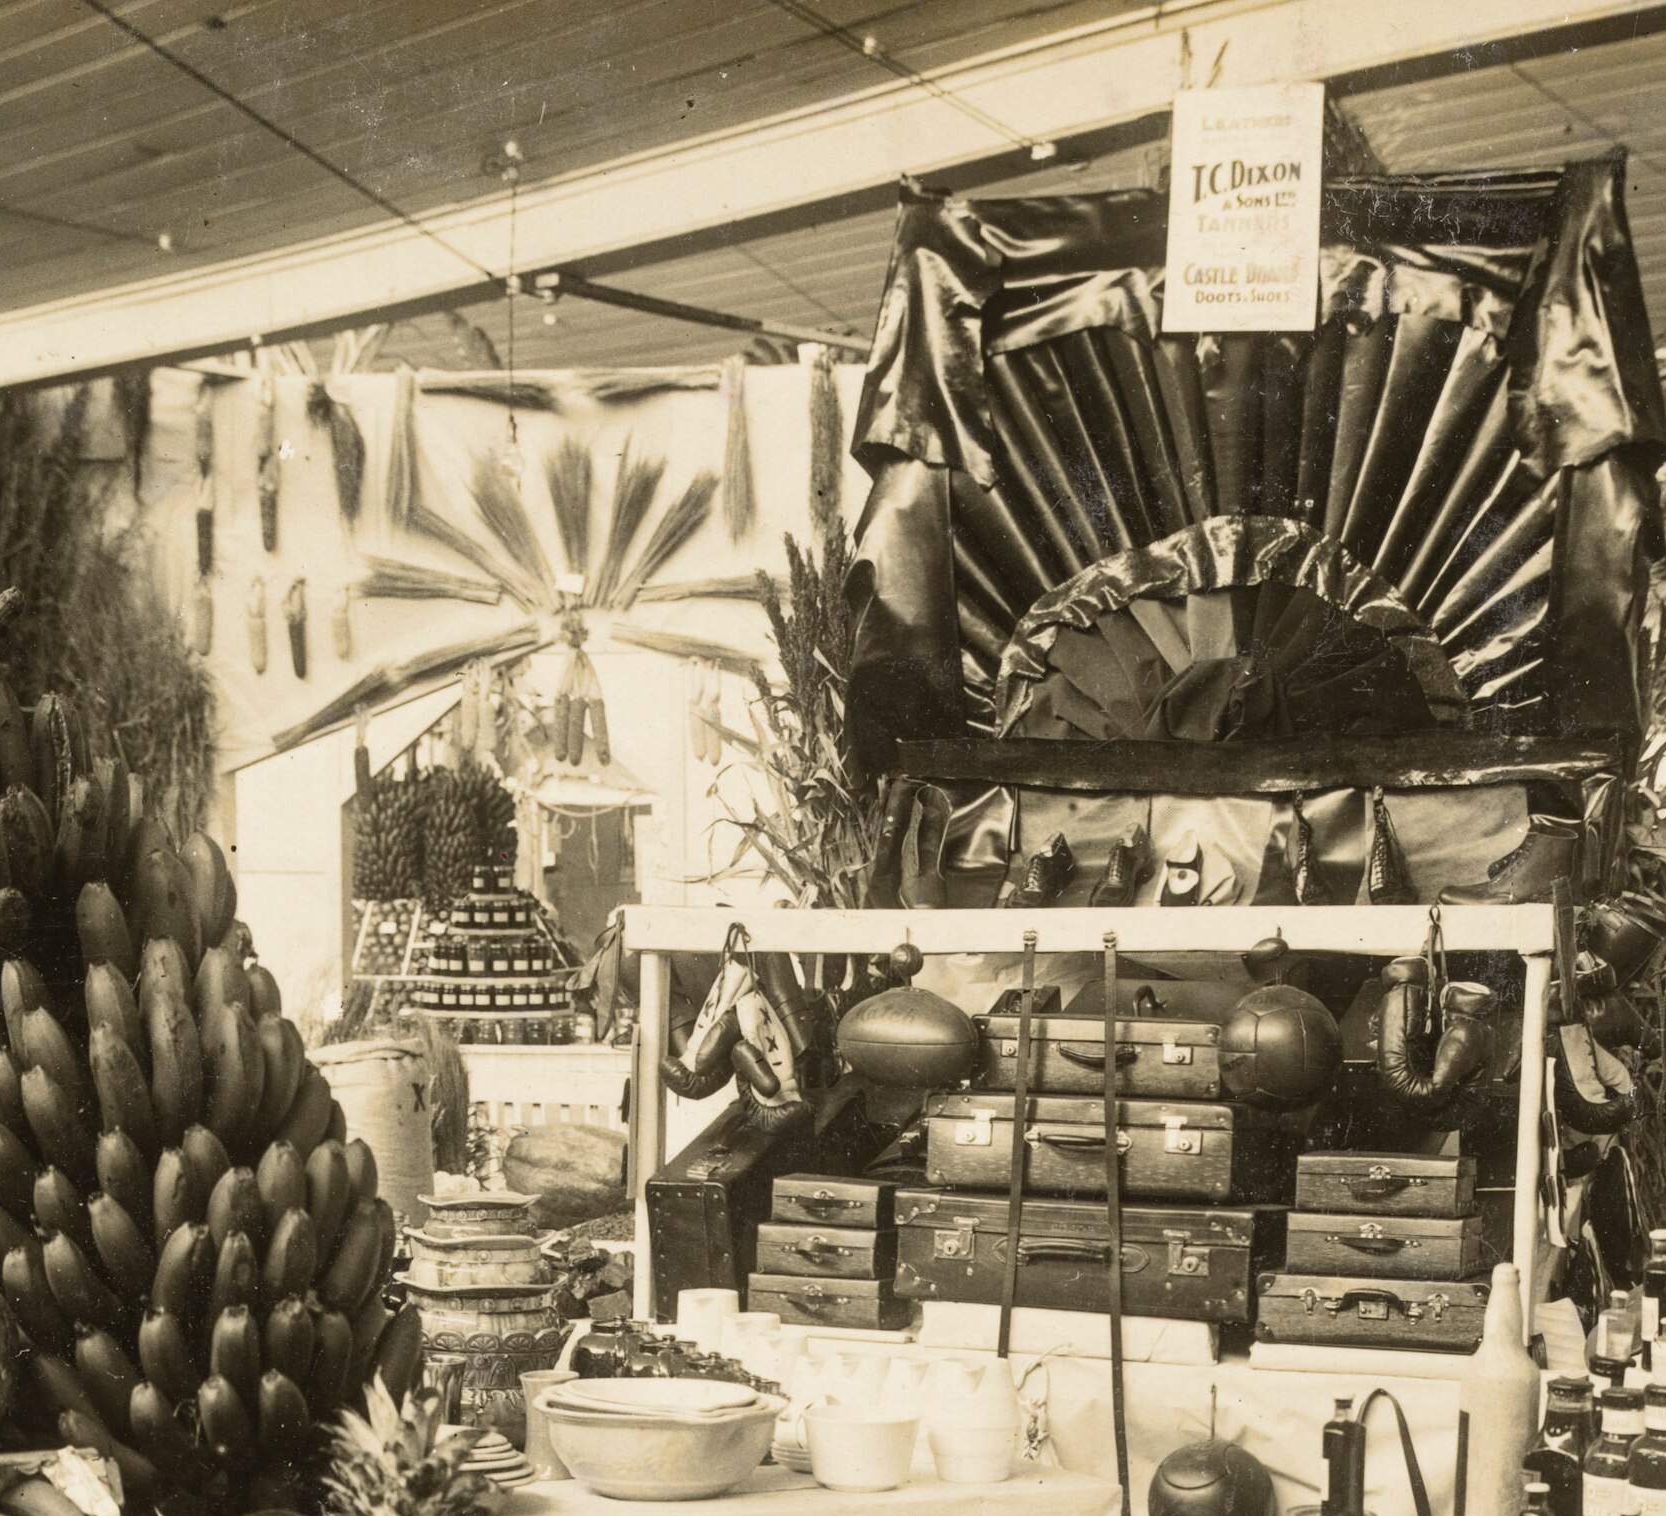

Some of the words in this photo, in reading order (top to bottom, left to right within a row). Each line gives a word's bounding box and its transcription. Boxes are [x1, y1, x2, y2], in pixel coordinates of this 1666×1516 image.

[1231, 160, 1301, 190] DIXON
[1237, 194, 1270, 209] SONS
[1184, 263, 1237, 285] CASTLE
